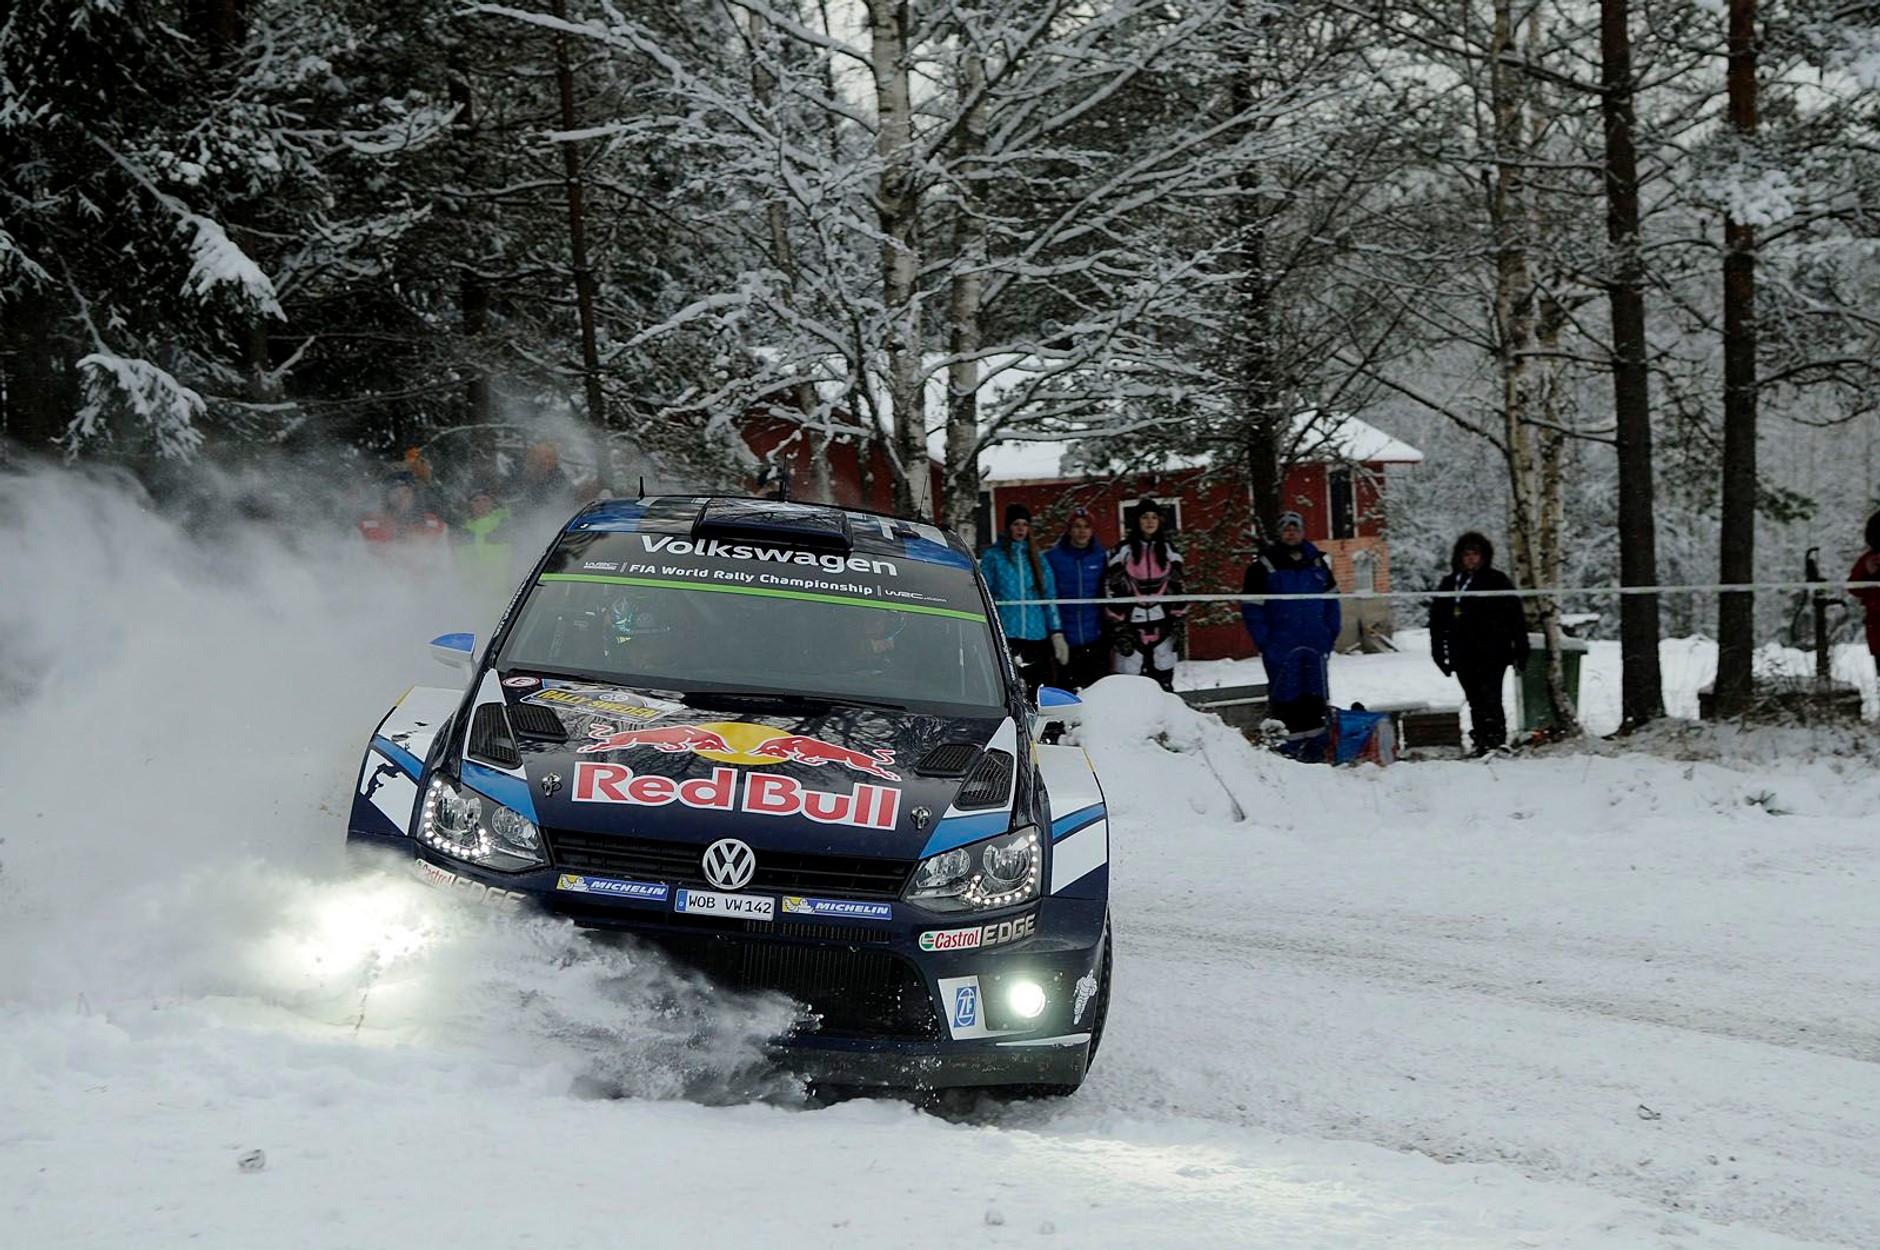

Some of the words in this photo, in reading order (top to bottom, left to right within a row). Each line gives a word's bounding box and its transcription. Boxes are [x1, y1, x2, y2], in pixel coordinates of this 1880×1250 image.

[640, 535, 898, 576] Volkswagen
[629, 564, 656, 574] FIA
[661, 566, 708, 578] World
[713, 570, 754, 583] Rally
[759, 573, 873, 595] Championship
[538, 690, 592, 703] RALLY
[589, 700, 661, 718] SWEDEN
[572, 761, 738, 810] Red
[742, 771, 901, 830] Bull
[590, 880, 667, 896] MICHELIN
[688, 895, 716, 909] WOB
[725, 898, 743, 911] VW
[745, 899, 772, 914] 142
[815, 902, 890, 915] MICHELIN
[934, 930, 979, 949] Castrol
[981, 913, 1036, 947] EDGE
[958, 993, 974, 1017] ZF
